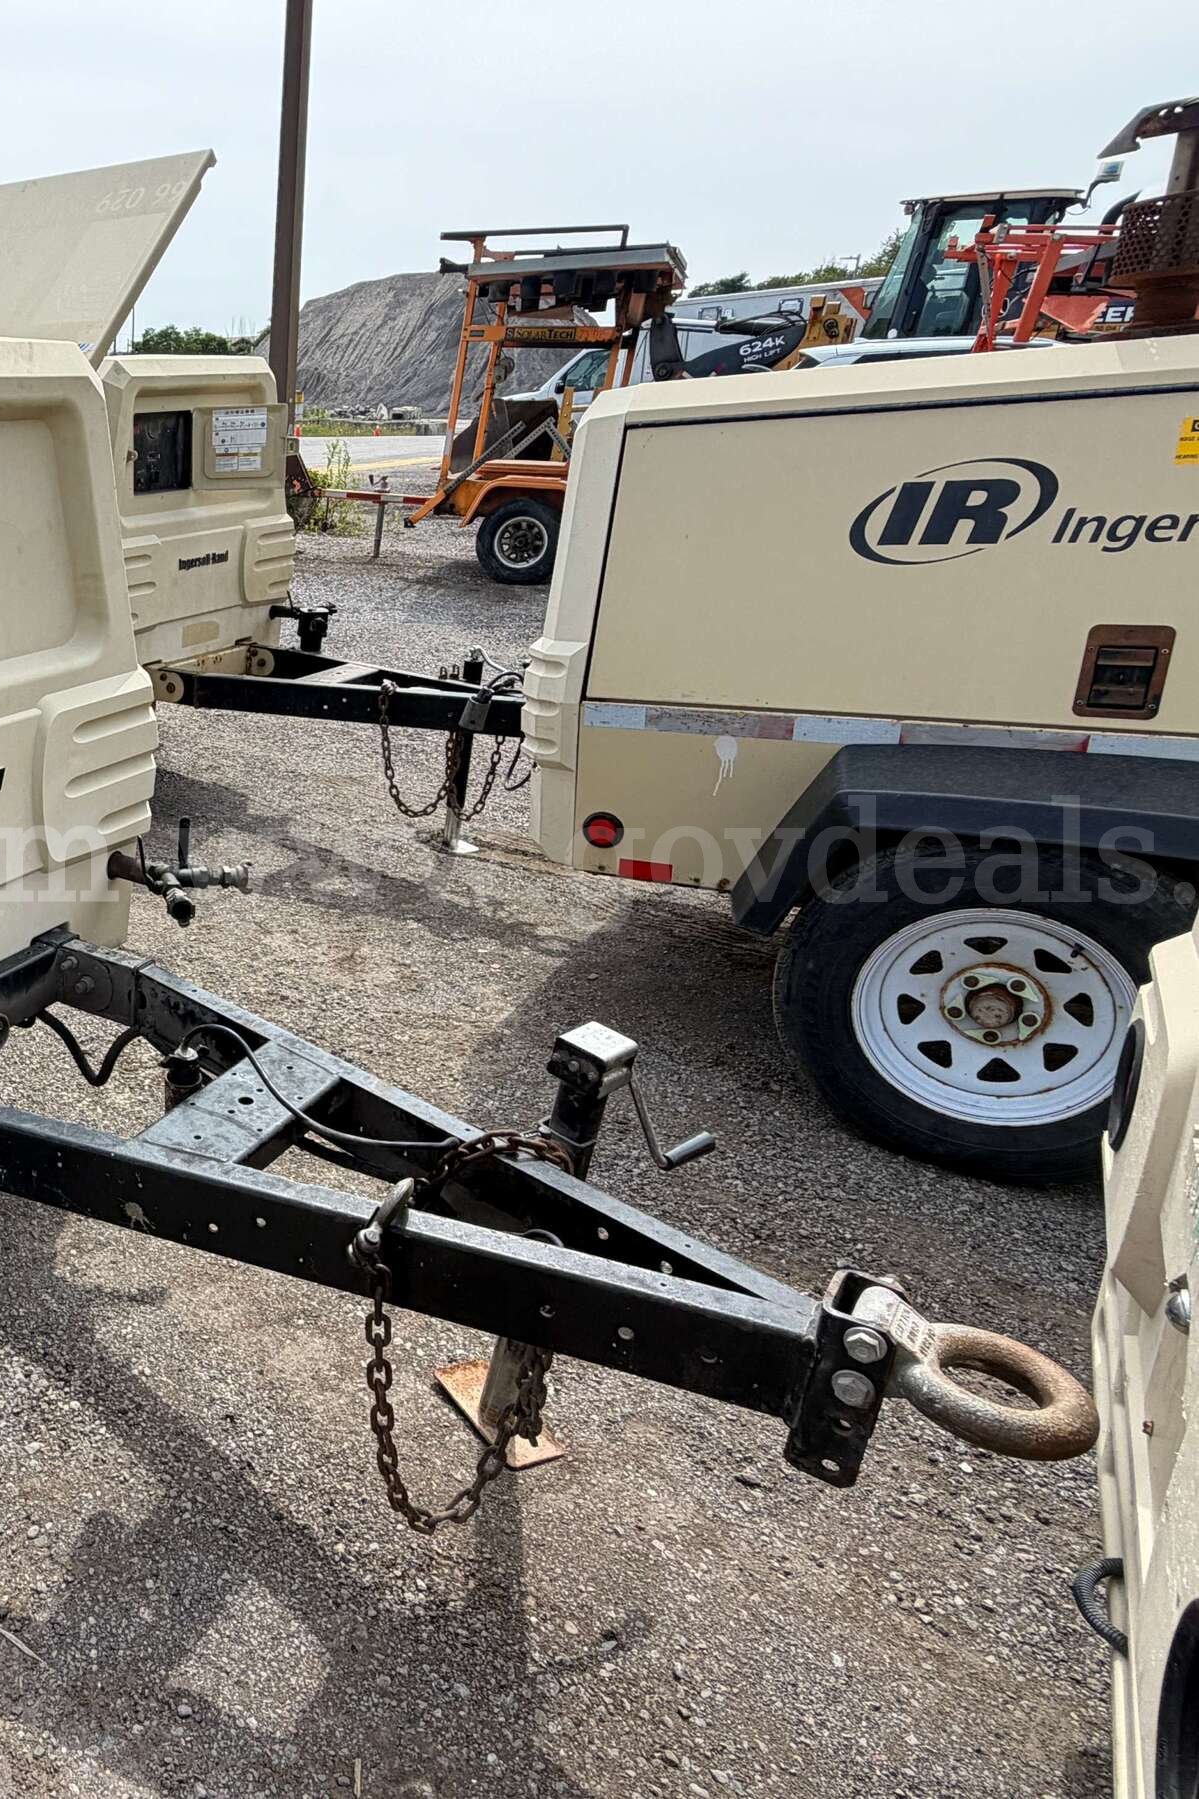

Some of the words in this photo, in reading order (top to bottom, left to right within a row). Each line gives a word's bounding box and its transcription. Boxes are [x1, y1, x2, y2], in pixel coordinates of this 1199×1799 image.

[739, 335, 785, 355] 624K
[743, 353, 762, 363] HIGH
[764, 347, 781, 358] LIFT
